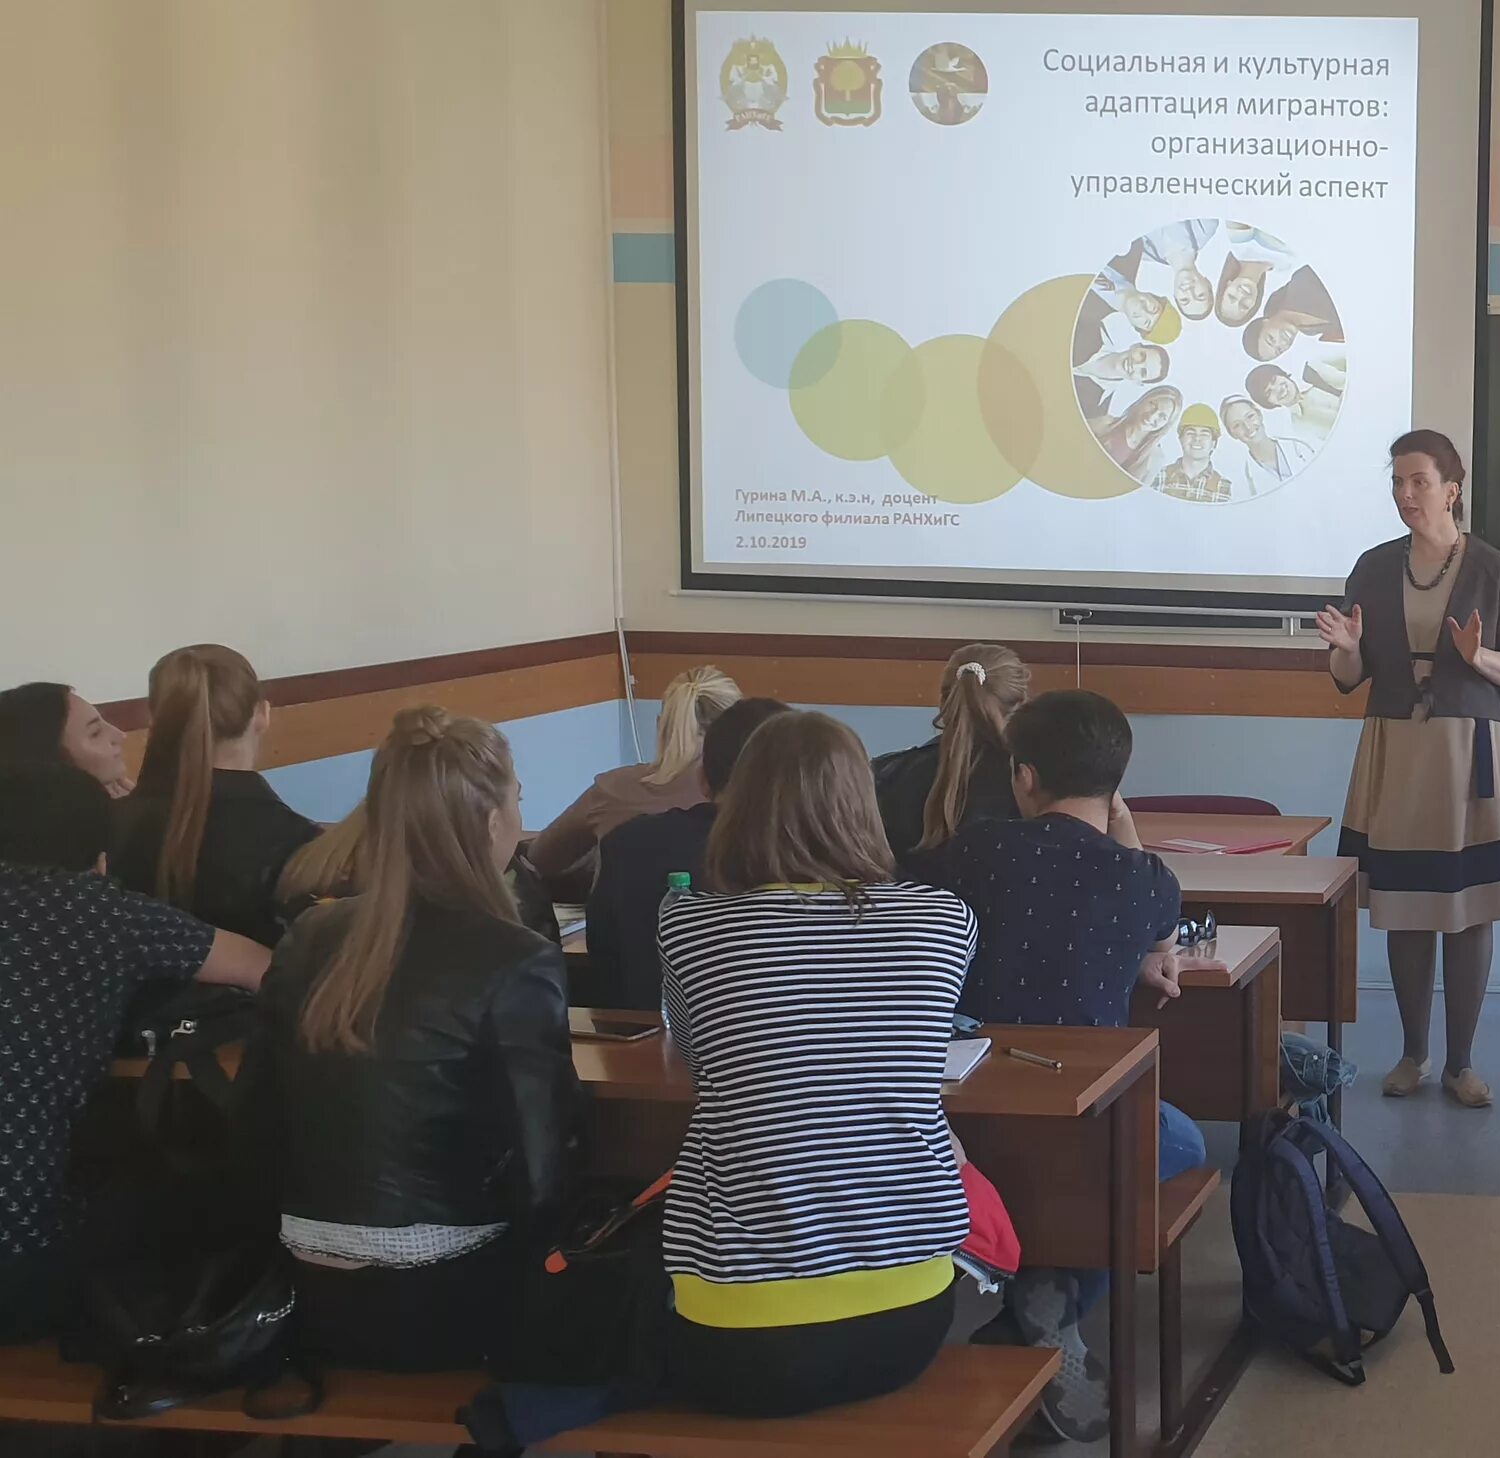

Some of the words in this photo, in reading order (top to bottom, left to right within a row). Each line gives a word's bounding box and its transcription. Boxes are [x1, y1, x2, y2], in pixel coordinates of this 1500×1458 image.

[1043, 48, 1205, 76] Социальная
[1213, 56, 1228, 74] и
[1238, 55, 1390, 80] культурная
[1085, 94, 1228, 119] адаптация
[1236, 96, 1389, 121] мигрантов:
[1151, 135, 1389, 160] организационно-
[1070, 172, 1292, 199] управленческий
[1299, 179, 1389, 199] аспект
[735, 489, 787, 504] Гурина
[791, 490, 832, 504] М.А.,
[835, 493, 876, 505] к.э.н,
[882, 494, 938, 507] доцент
[735, 510, 818, 525] Липецкого
[821, 510, 890, 527] филиала
[893, 513, 961, 526] РАНХиГС
[735, 536, 807, 549] 2.10.2019
